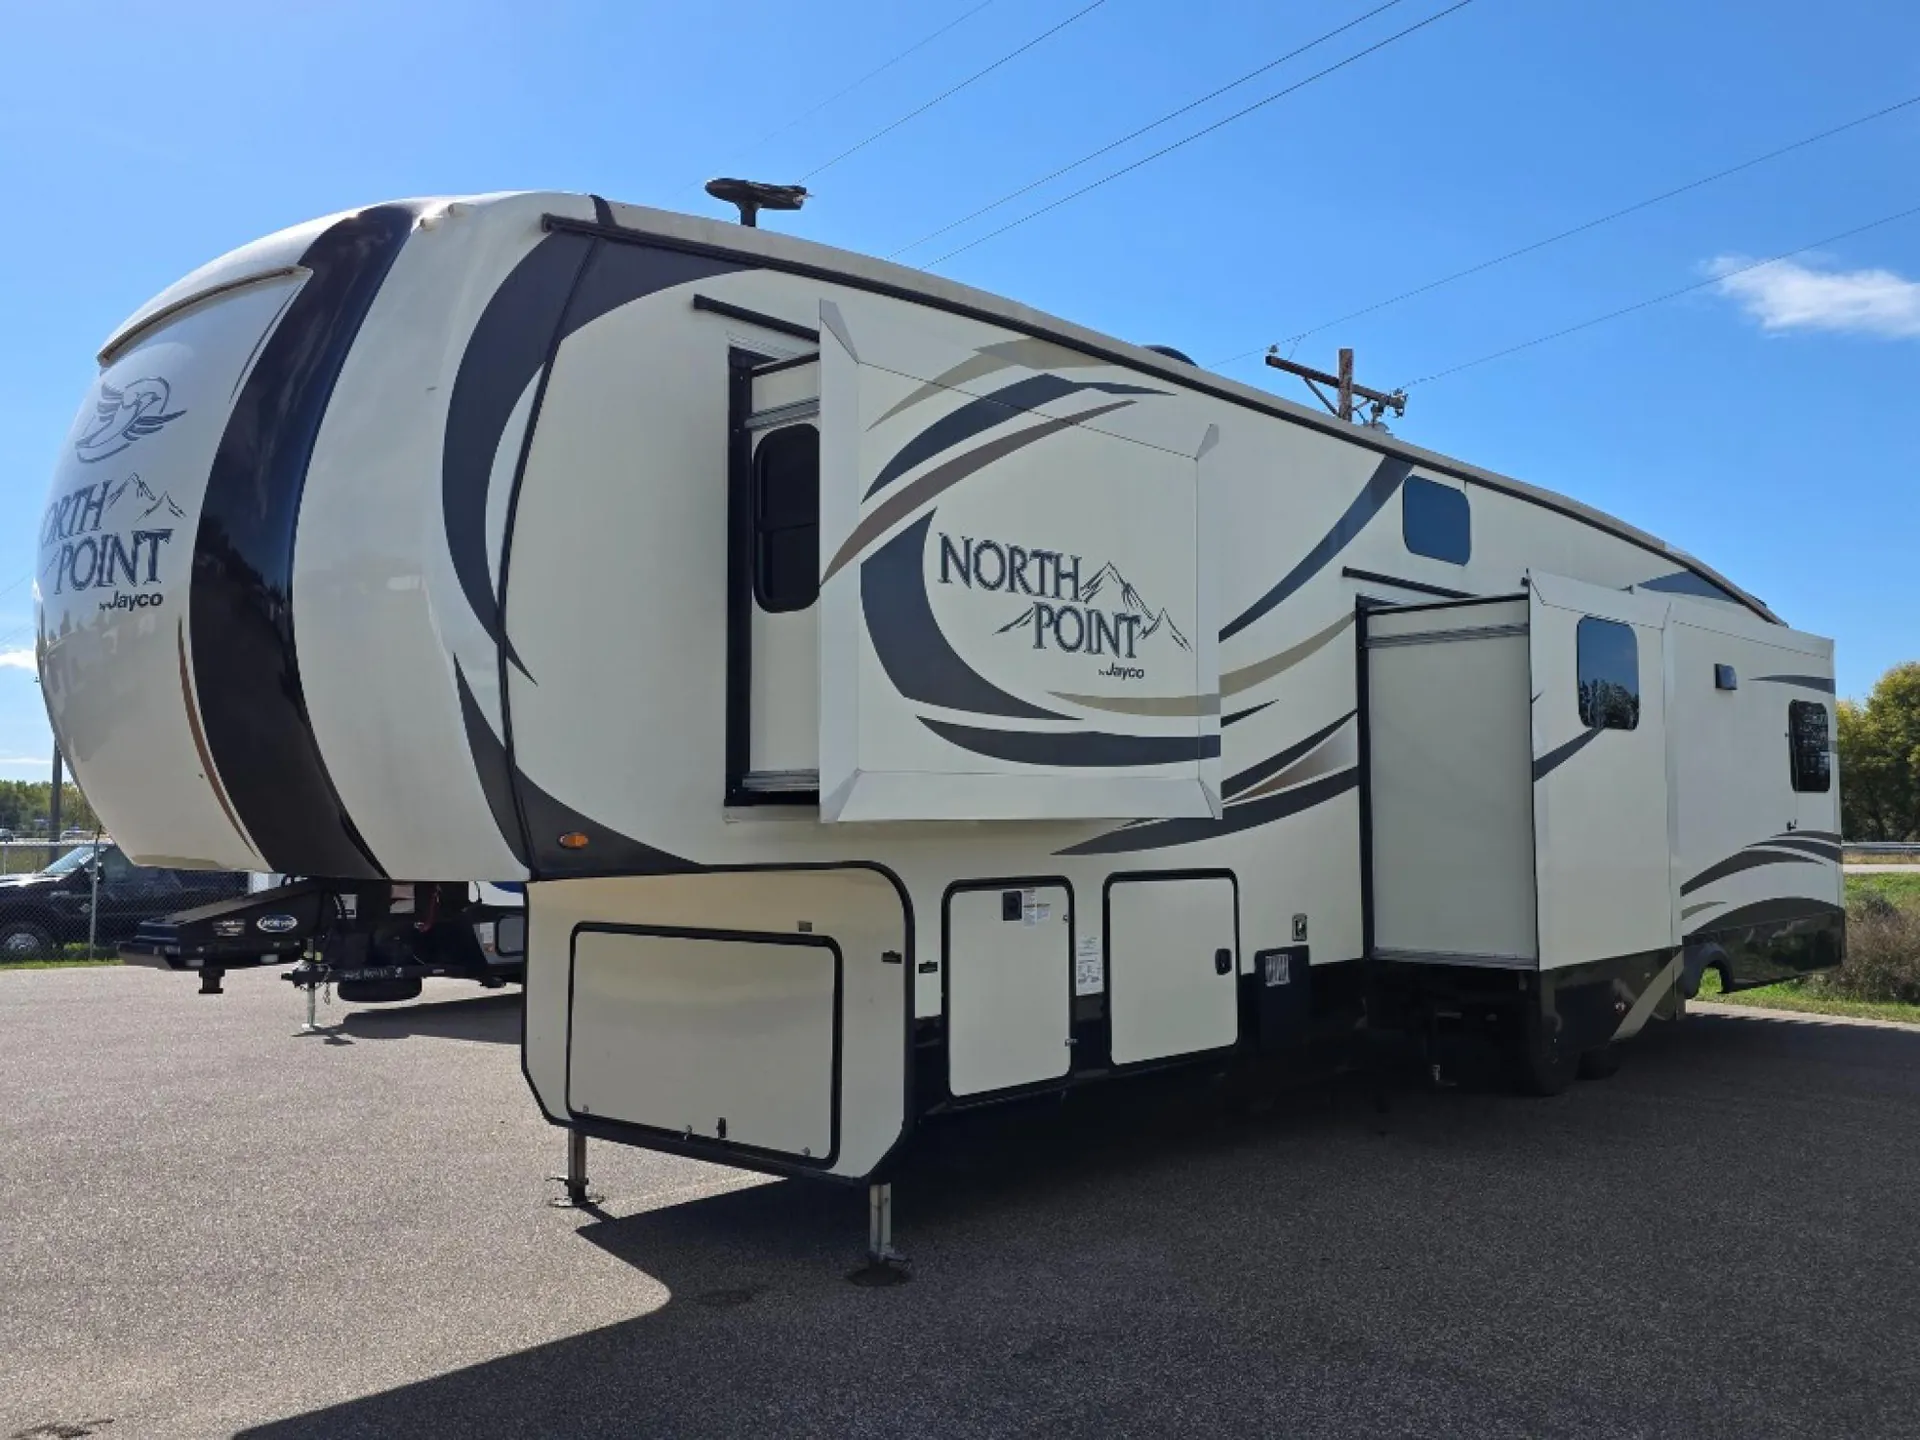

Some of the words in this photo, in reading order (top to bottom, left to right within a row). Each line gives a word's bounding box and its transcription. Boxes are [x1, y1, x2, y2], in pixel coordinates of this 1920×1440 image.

[42, 479, 113, 549] ORTH
[53, 527, 175, 595] POINT
[937, 531, 1082, 602] NORTH
[109, 590, 164, 612] Jayco
[1032, 601, 1141, 659] POINT
[1105, 661, 1145, 681] Jayco
